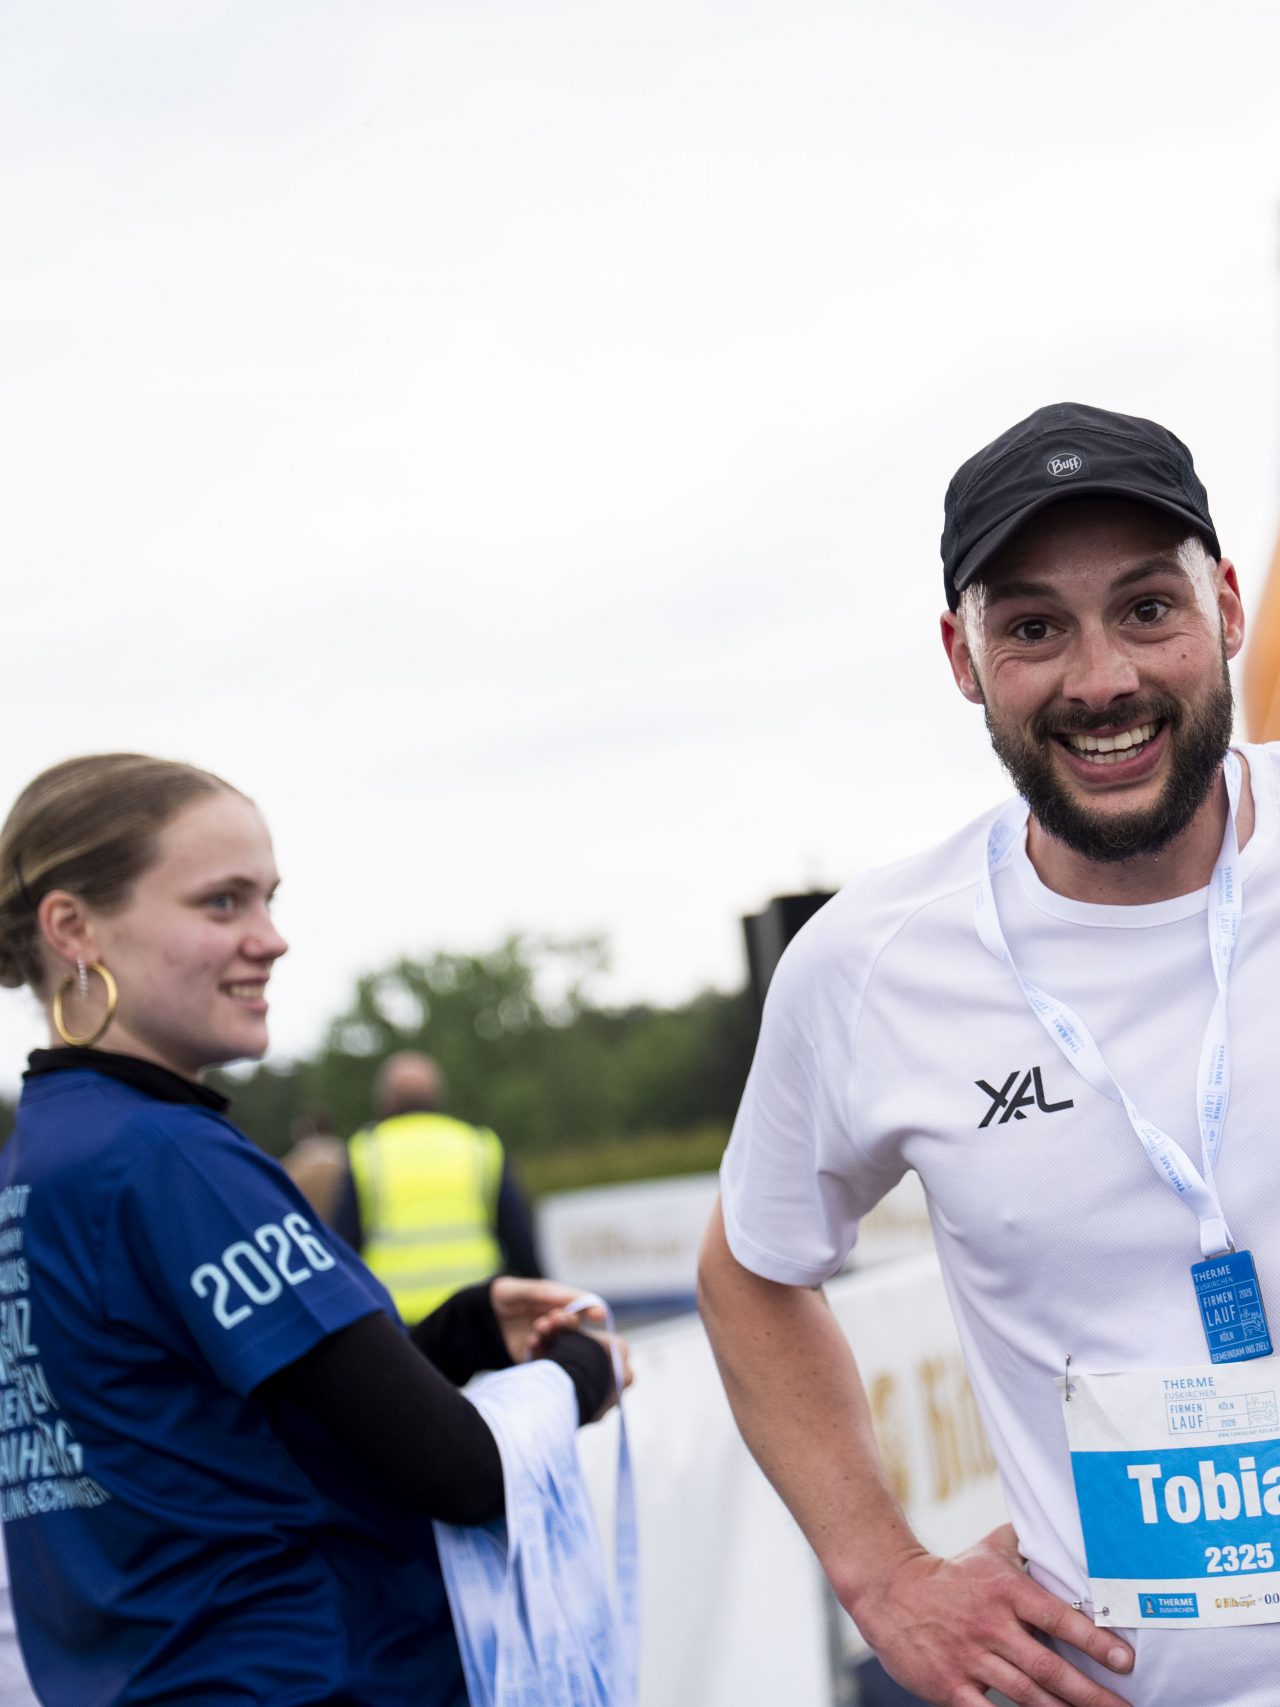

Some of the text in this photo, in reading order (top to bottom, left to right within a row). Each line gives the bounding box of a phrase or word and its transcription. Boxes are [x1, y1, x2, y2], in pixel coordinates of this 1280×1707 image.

[1050, 456, 1079, 475] Buff
[1223, 866, 1233, 904] THERME
[1052, 1017, 1080, 1054] THERME
[1214, 1045, 1225, 1086] THERME
[974, 1065, 1075, 1130] XAL
[1160, 1153, 1186, 1192] THERME
[190, 1212, 336, 1331] 2026
[1193, 1265, 1231, 1282] THERME
[1196, 1277, 1234, 1292] EUSKIRCHEN
[1203, 1291, 1234, 1308] FIRMEN
[1206, 1305, 1236, 1327] LAUF
[1163, 1376, 1215, 1390] THERME
[1164, 1389, 1216, 1400] EUSKIRCHEN
[1170, 1403, 1202, 1413] FIRMEN
[1218, 1401, 1234, 1410] KÖLN
[1171, 1415, 1203, 1430] LAUF
[1204, 1542, 1275, 1573] 2325
[1158, 1598, 1194, 1606] THERME
